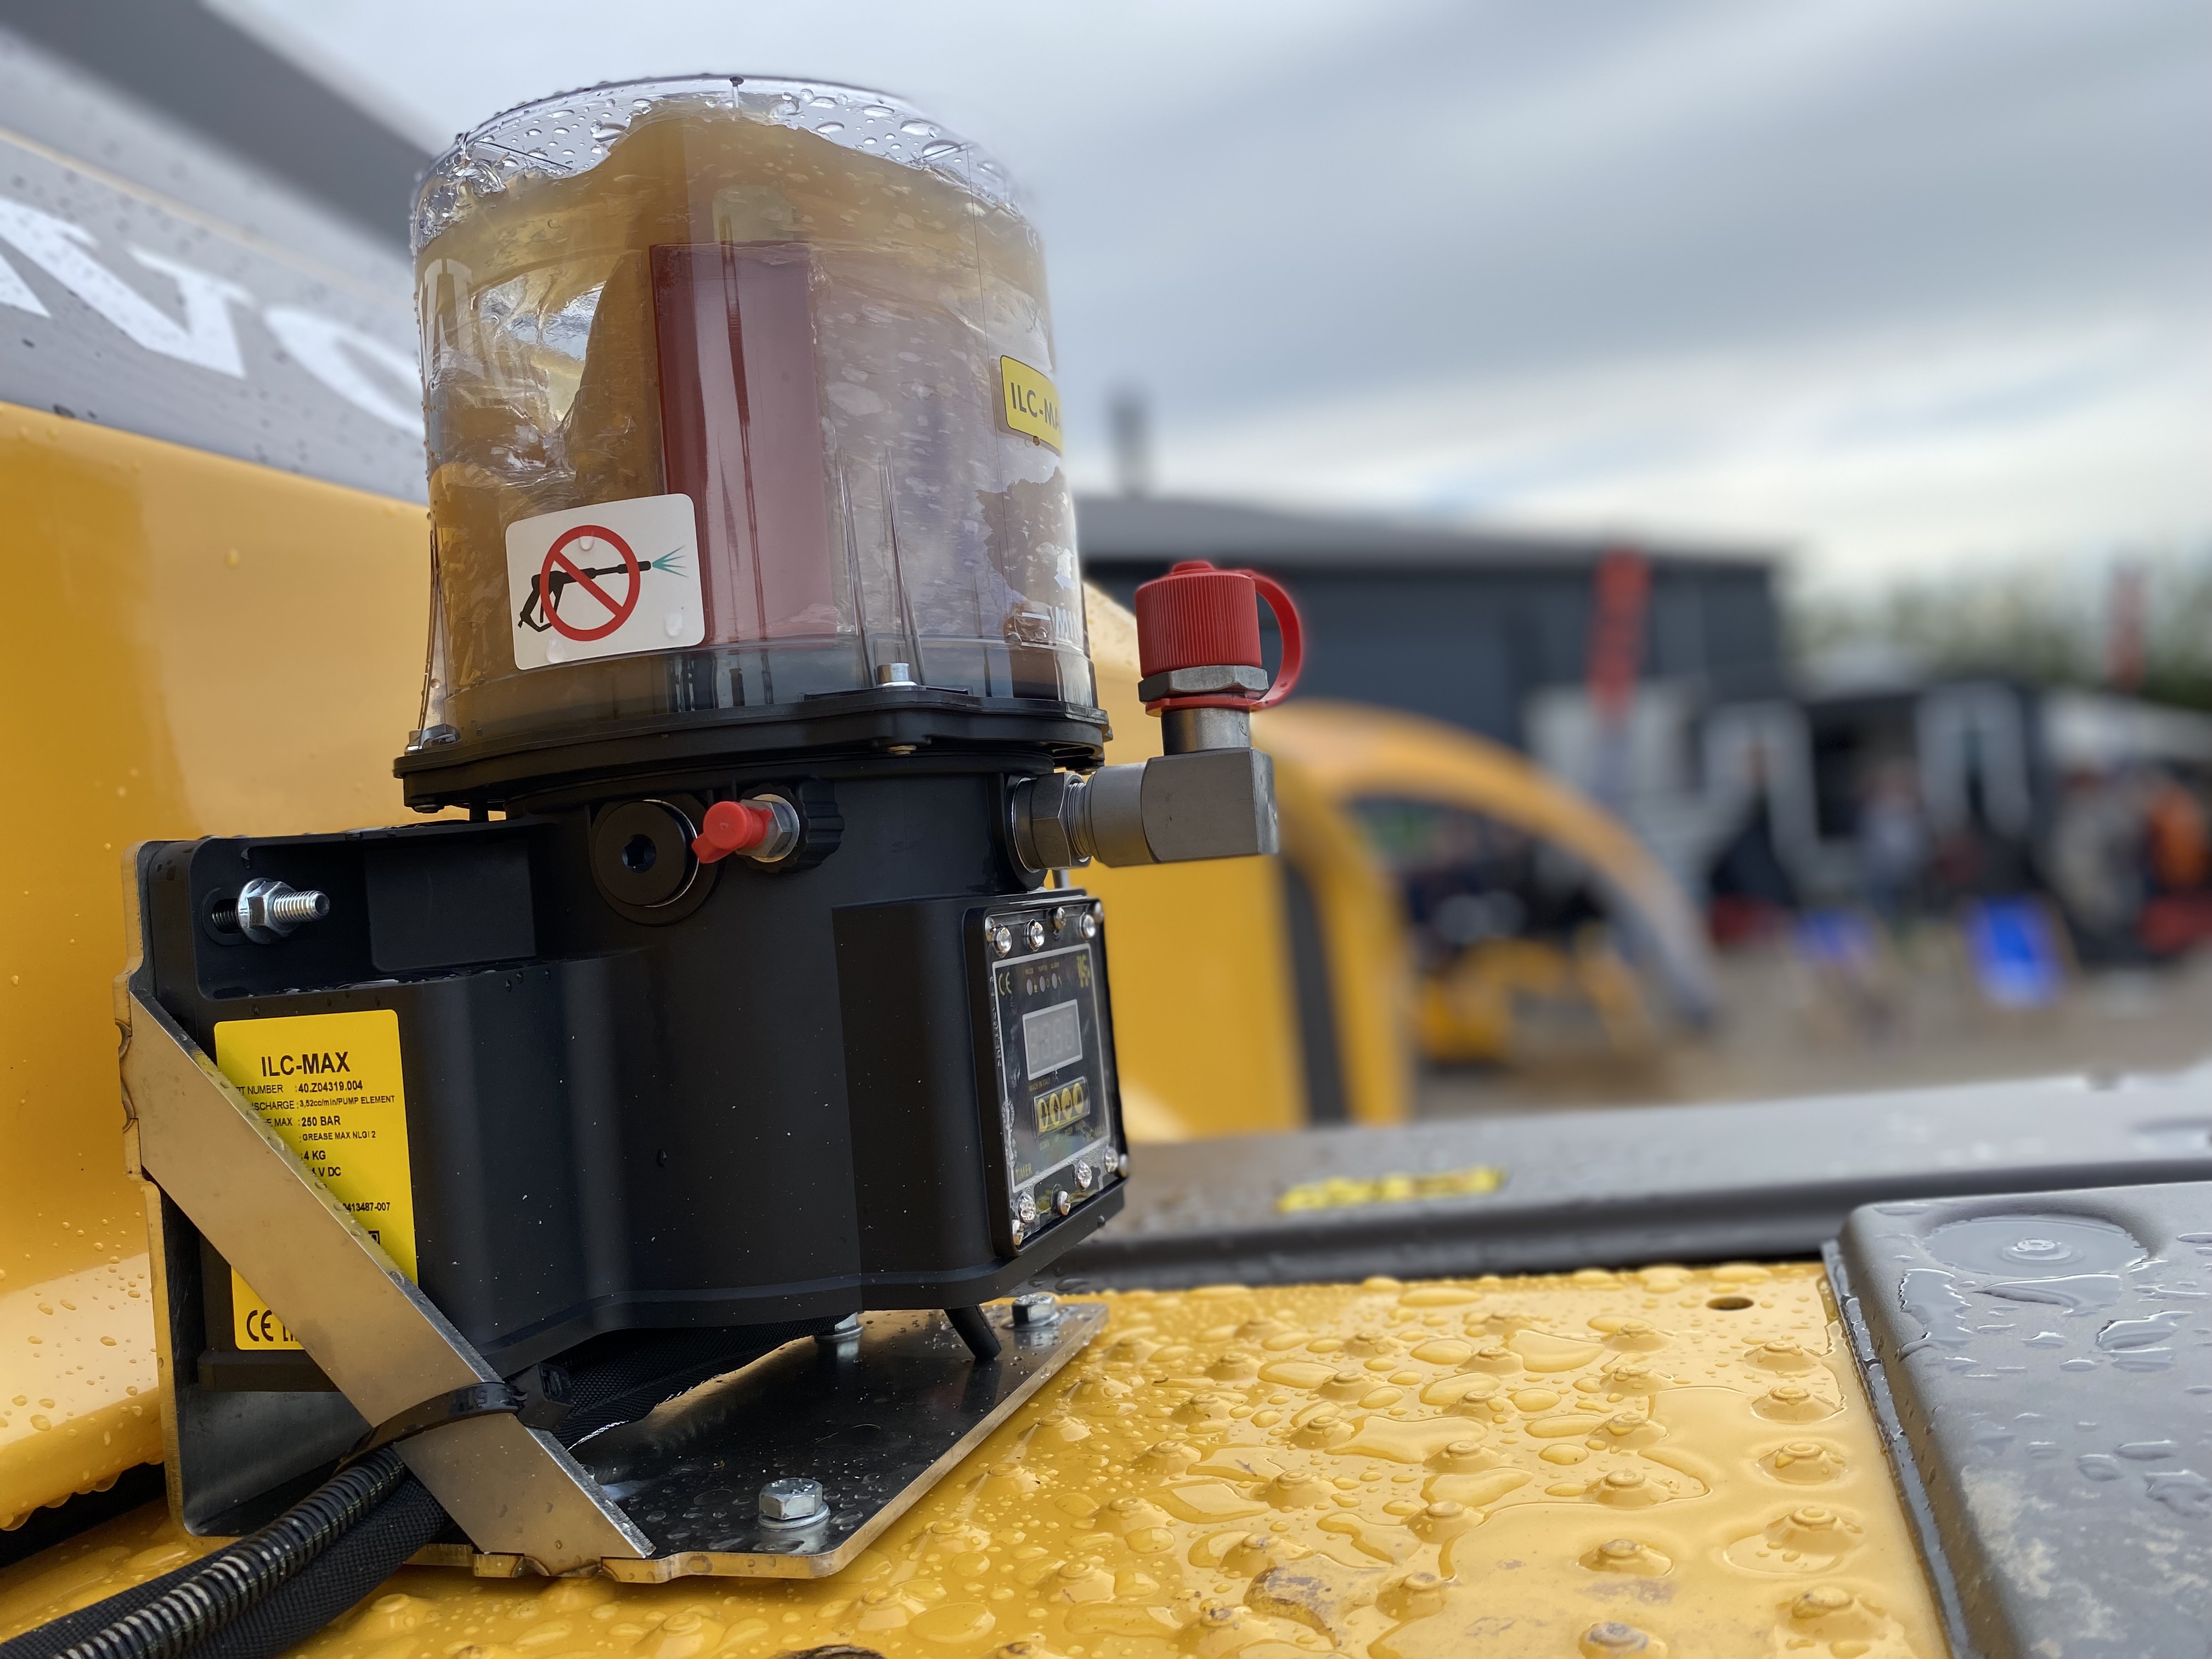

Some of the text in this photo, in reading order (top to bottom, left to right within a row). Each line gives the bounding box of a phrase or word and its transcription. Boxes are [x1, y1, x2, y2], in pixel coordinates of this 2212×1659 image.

[261, 1051, 351, 1077] ILC-MAX
[247, 1085, 284, 1094] NUMBER
[252, 1101, 295, 1111] SCHARGE
[361, 1095, 395, 1104] ELEMENT
[274, 1117, 293, 1127] MAX
[320, 1115, 341, 1126] BAR
[335, 1131, 351, 1140] MAX
[371, 1130, 376, 1138] 2
[312, 1150, 326, 1161] KG
[318, 1167, 325, 1177] V
[328, 1166, 341, 1177] DC
[1015, 1163, 1032, 1182] TIMER
[246, 1310, 274, 1342] CE
